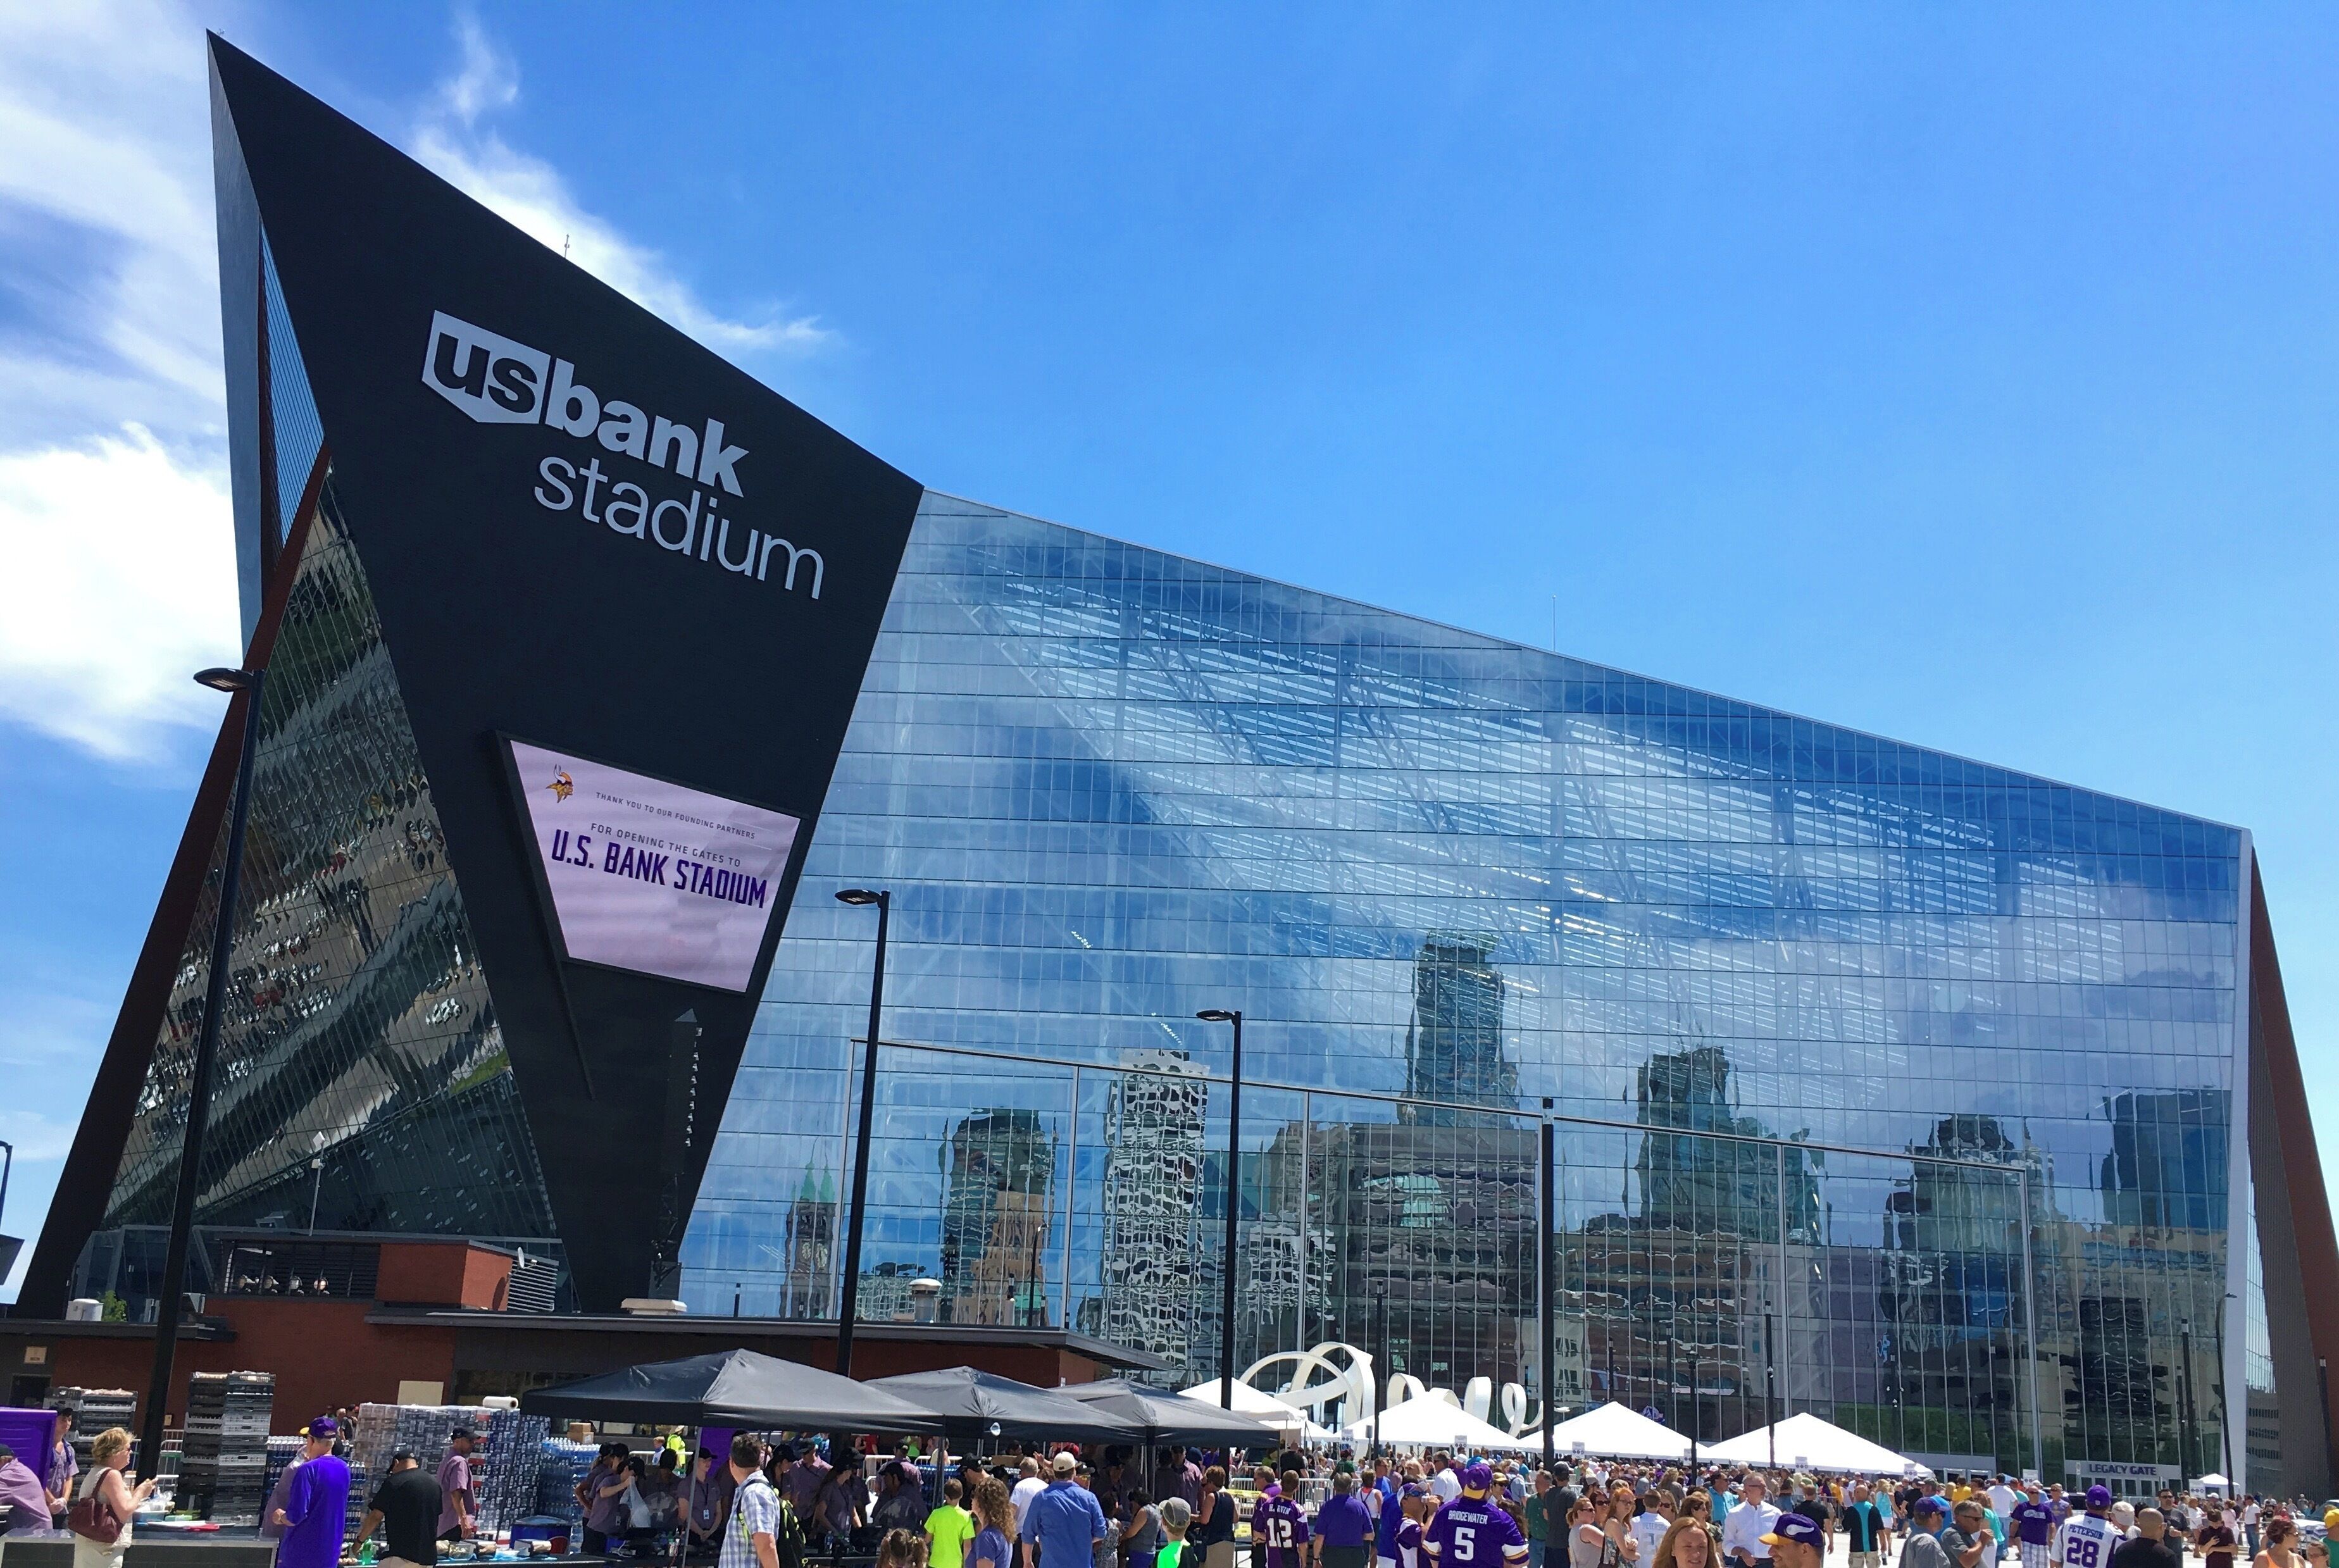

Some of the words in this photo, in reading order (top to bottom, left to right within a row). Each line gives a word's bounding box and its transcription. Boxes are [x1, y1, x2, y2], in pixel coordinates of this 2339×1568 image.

[534, 456, 824, 600] stadium
[596, 792, 624, 805] THANK
[626, 799, 642, 810] YOU
[644, 804, 654, 813] TO
[657, 808, 673, 818] OUR
[675, 812, 714, 829] FOUNDING
[716, 823, 756, 839] PARTNERS
[590, 823, 612, 835] FOR
[616, 829, 665, 849] OPENING
[668, 842, 689, 854] THE
[692, 848, 725, 863] GATES
[728, 857, 741, 868] TO
[551, 828, 595, 869] U.S.
[603, 842, 670, 886] BANK
[673, 859, 768, 909] STADIUM
[2088, 1463, 2128, 1474] LEGACY
[2130, 1465, 2157, 1476] GATE
[1266, 1517, 1292, 1548] 12
[1447, 1510, 1488, 1525] BRIDGEWATER
[2068, 1524, 2105, 1540] PETERSON
[1454, 1526, 1476, 1561] 5
[2066, 1536, 2100, 1568] 28
